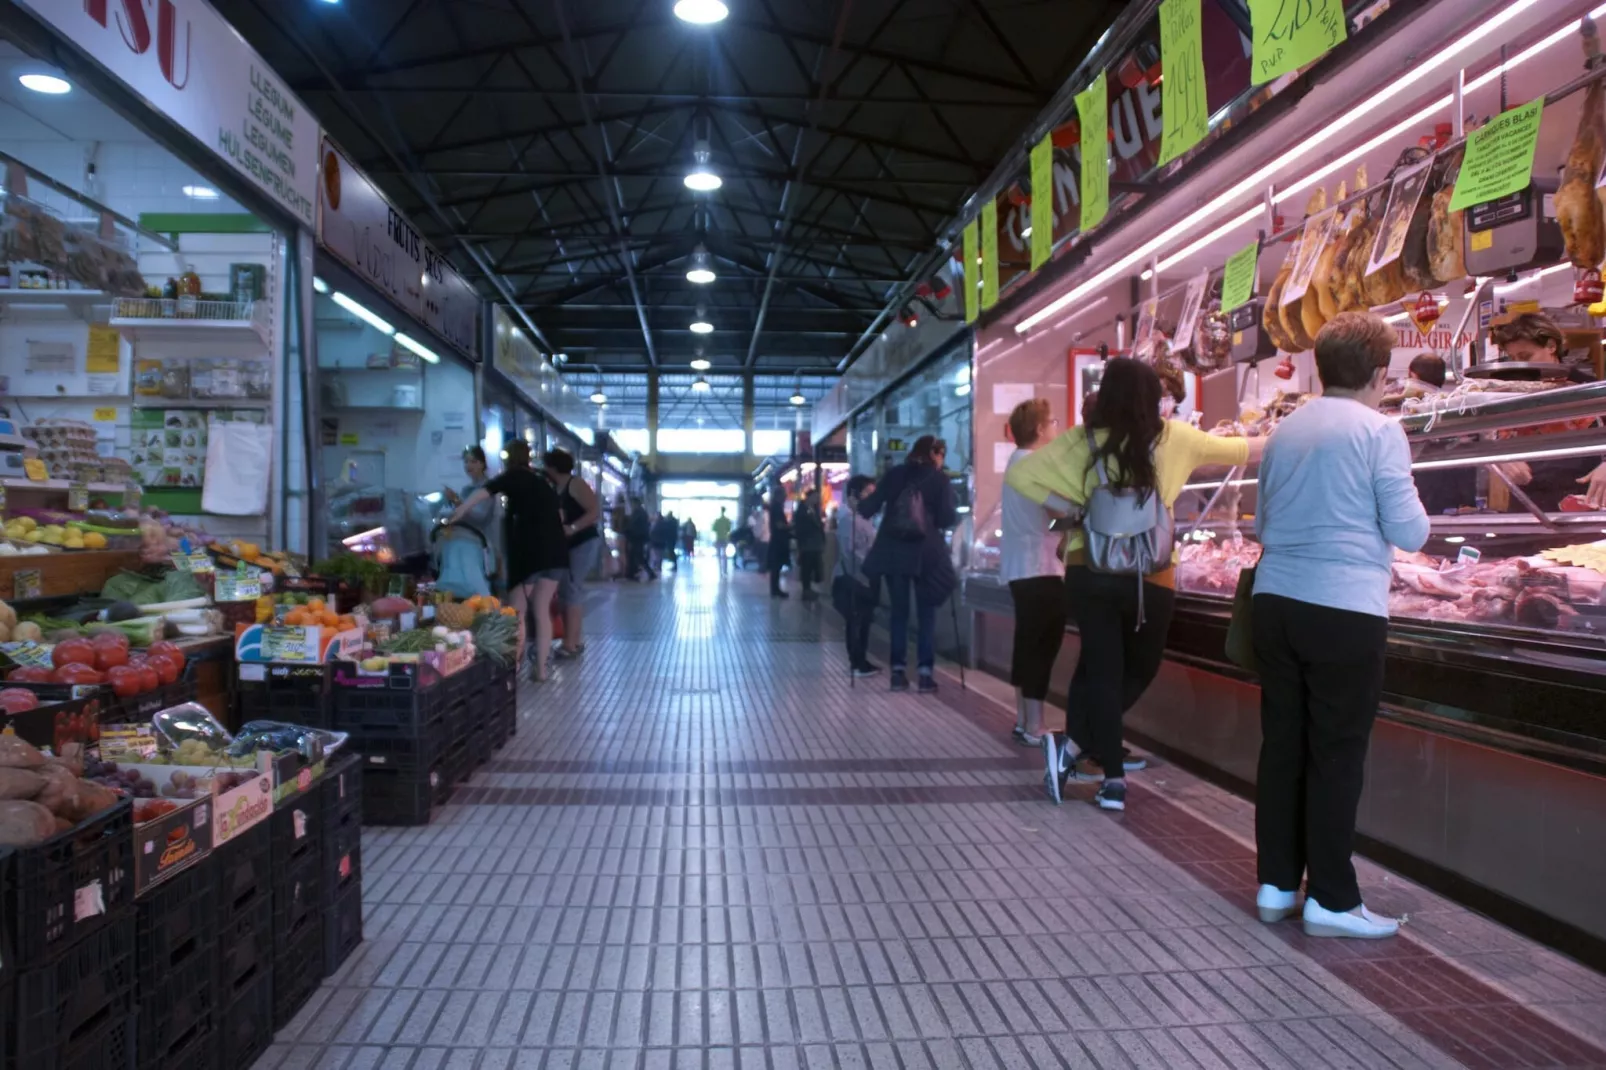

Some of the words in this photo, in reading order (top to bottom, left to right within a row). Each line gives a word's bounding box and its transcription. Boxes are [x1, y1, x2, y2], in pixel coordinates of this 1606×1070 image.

[249, 63, 295, 122] LLEGUM
[242, 116, 296, 179] LEGUMEN
[387, 205, 421, 263] FRUITS
[424, 245, 444, 285] SECS
